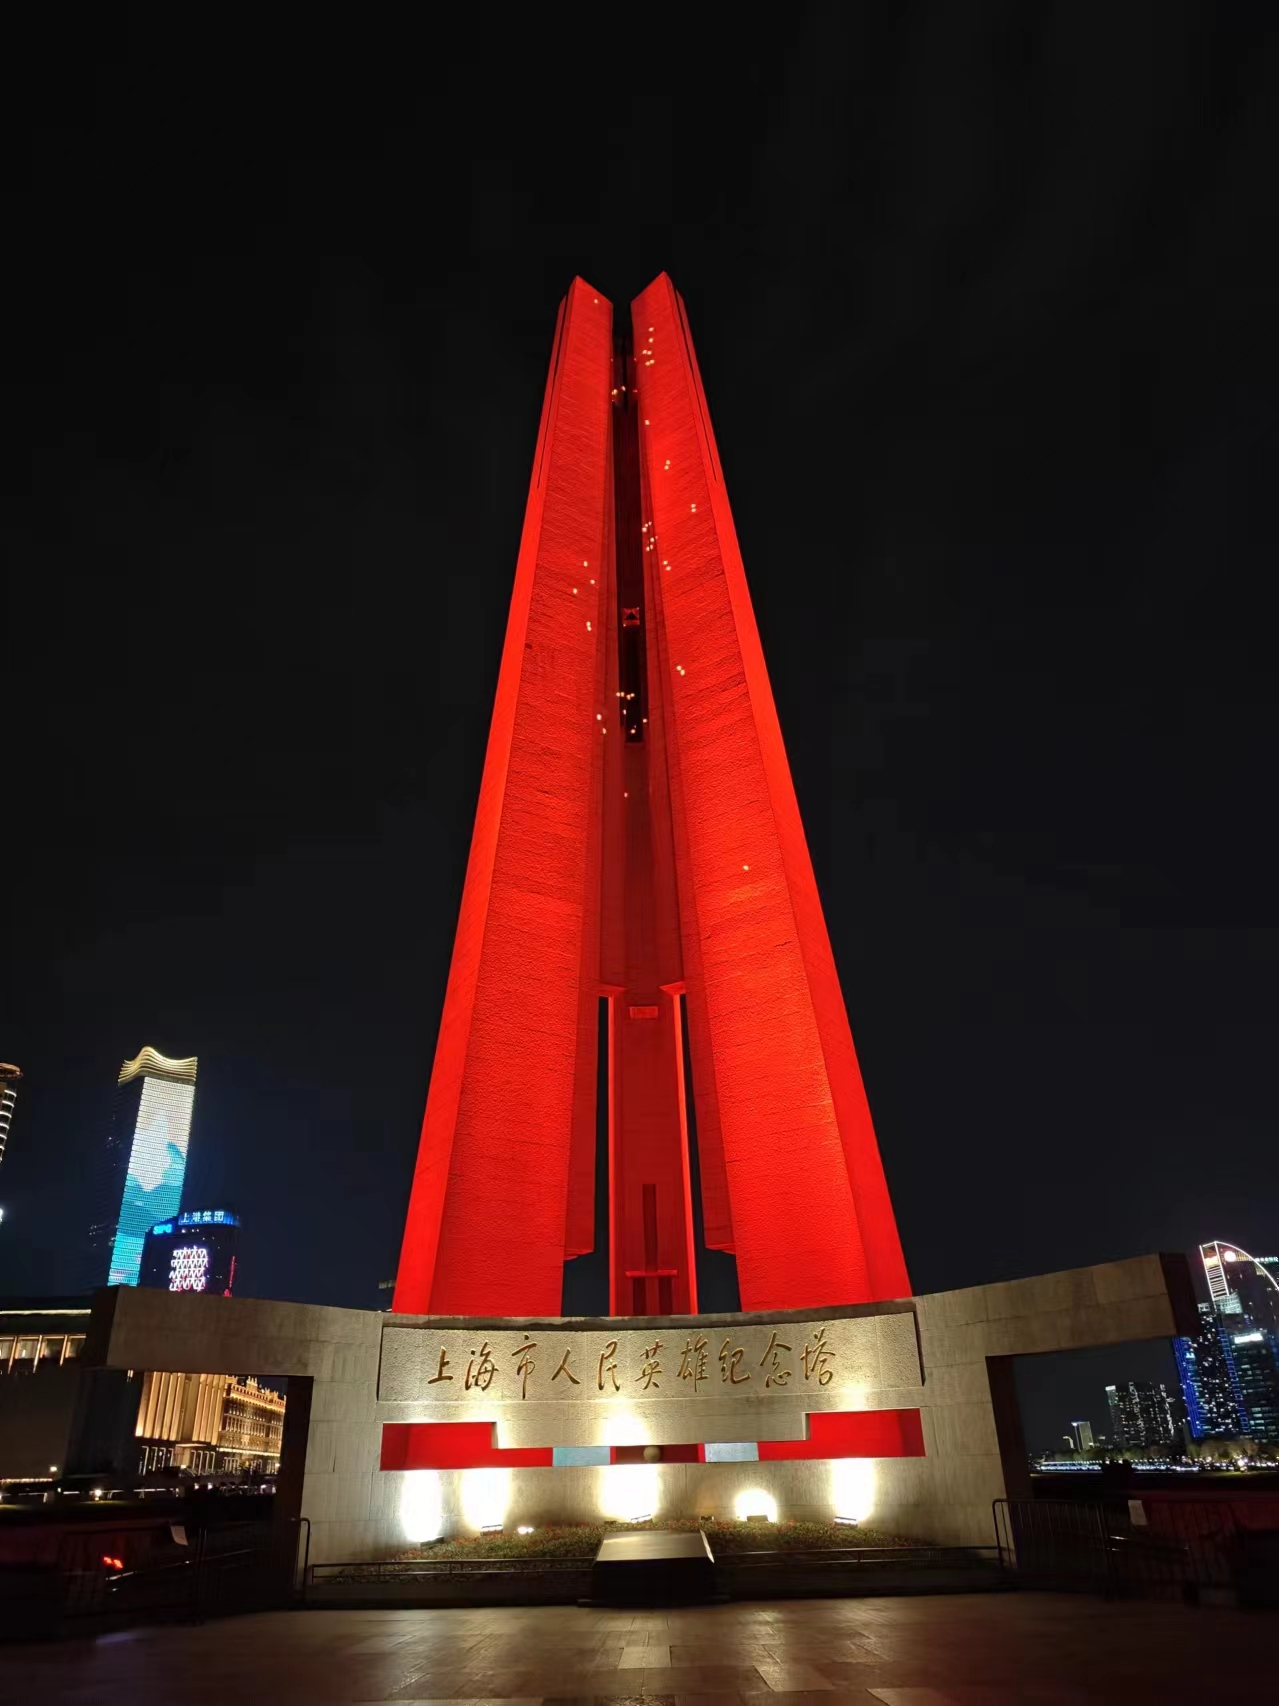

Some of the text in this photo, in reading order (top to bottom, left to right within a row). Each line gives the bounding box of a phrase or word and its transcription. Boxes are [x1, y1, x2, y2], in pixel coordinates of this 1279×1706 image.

[427, 1327, 837, 1400] 上海市人民英雄纪念塔
